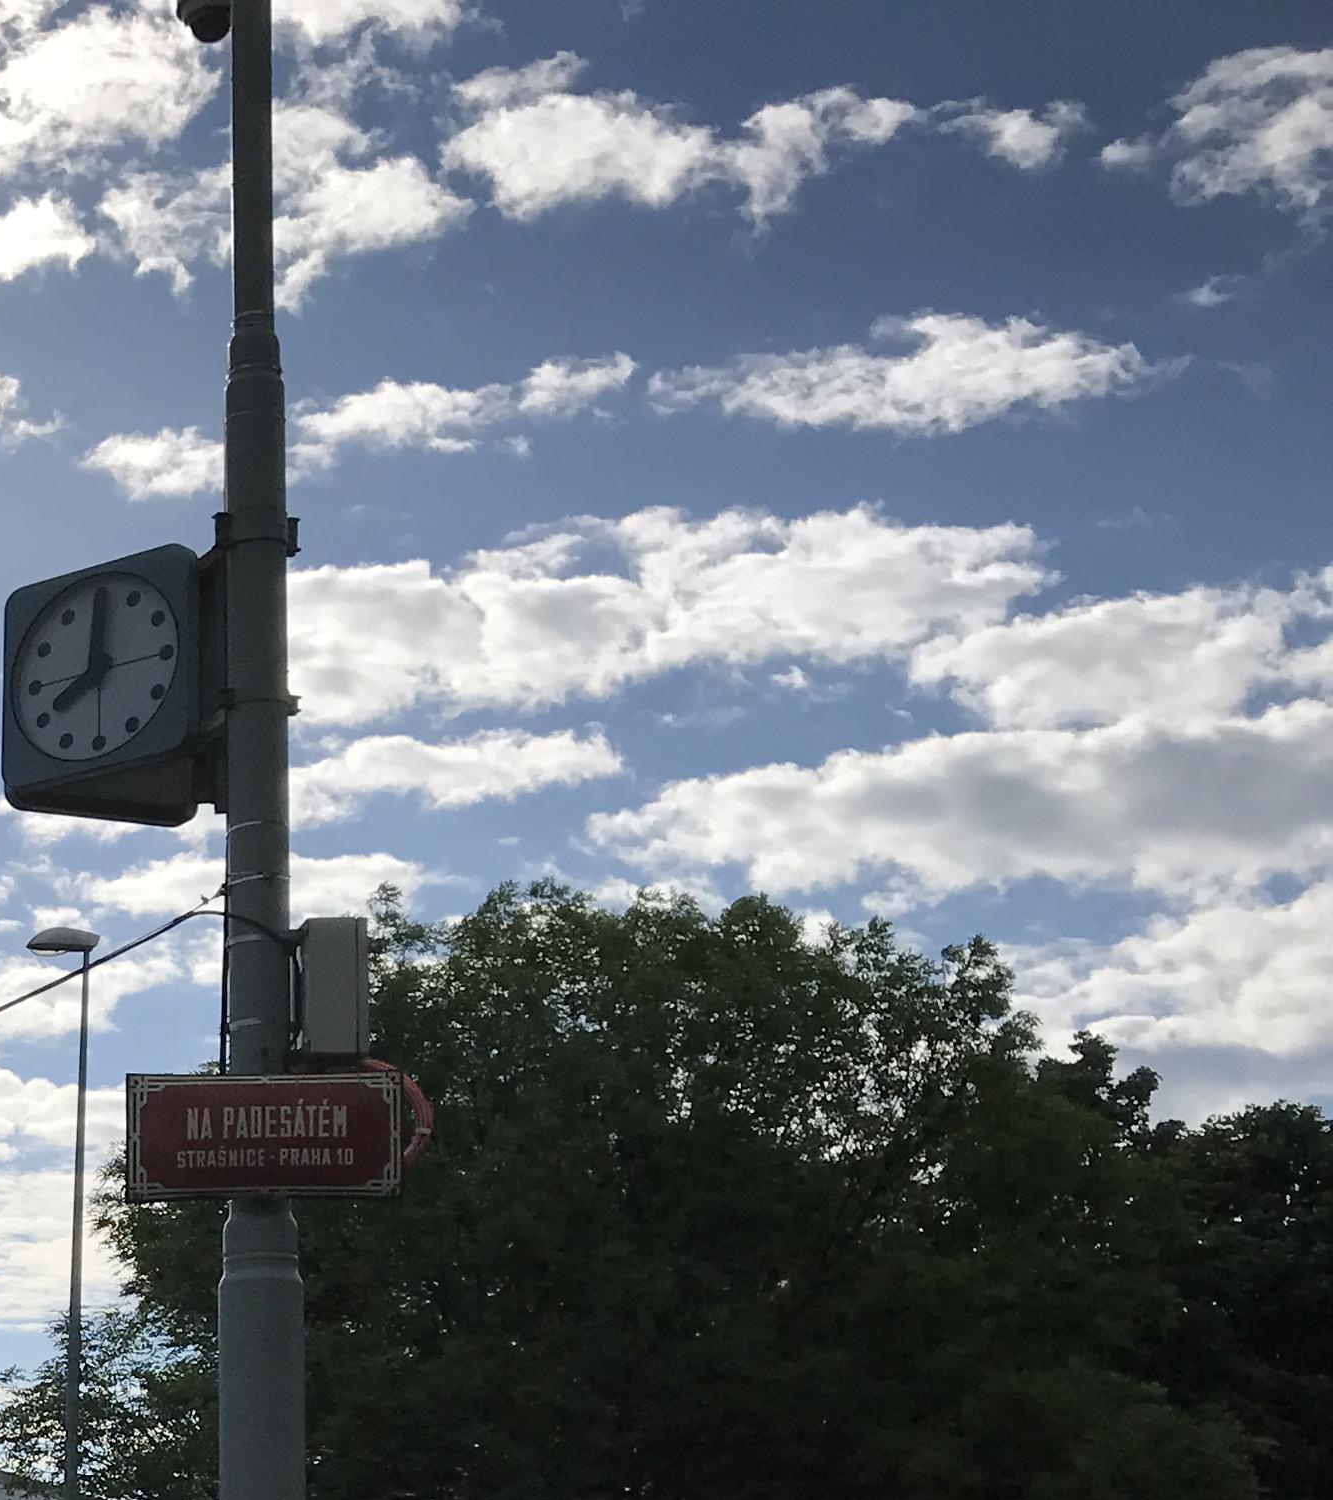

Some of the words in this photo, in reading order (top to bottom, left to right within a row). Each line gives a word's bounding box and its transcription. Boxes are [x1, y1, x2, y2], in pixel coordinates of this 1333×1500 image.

[186, 1107, 212, 1140] NA
[222, 1099, 348, 1139] PADESÁTÉM
[176, 1146, 265, 1168] STRAŠNICE
[279, 1148, 331, 1167] PRAHA
[337, 1148, 354, 1166] 10
